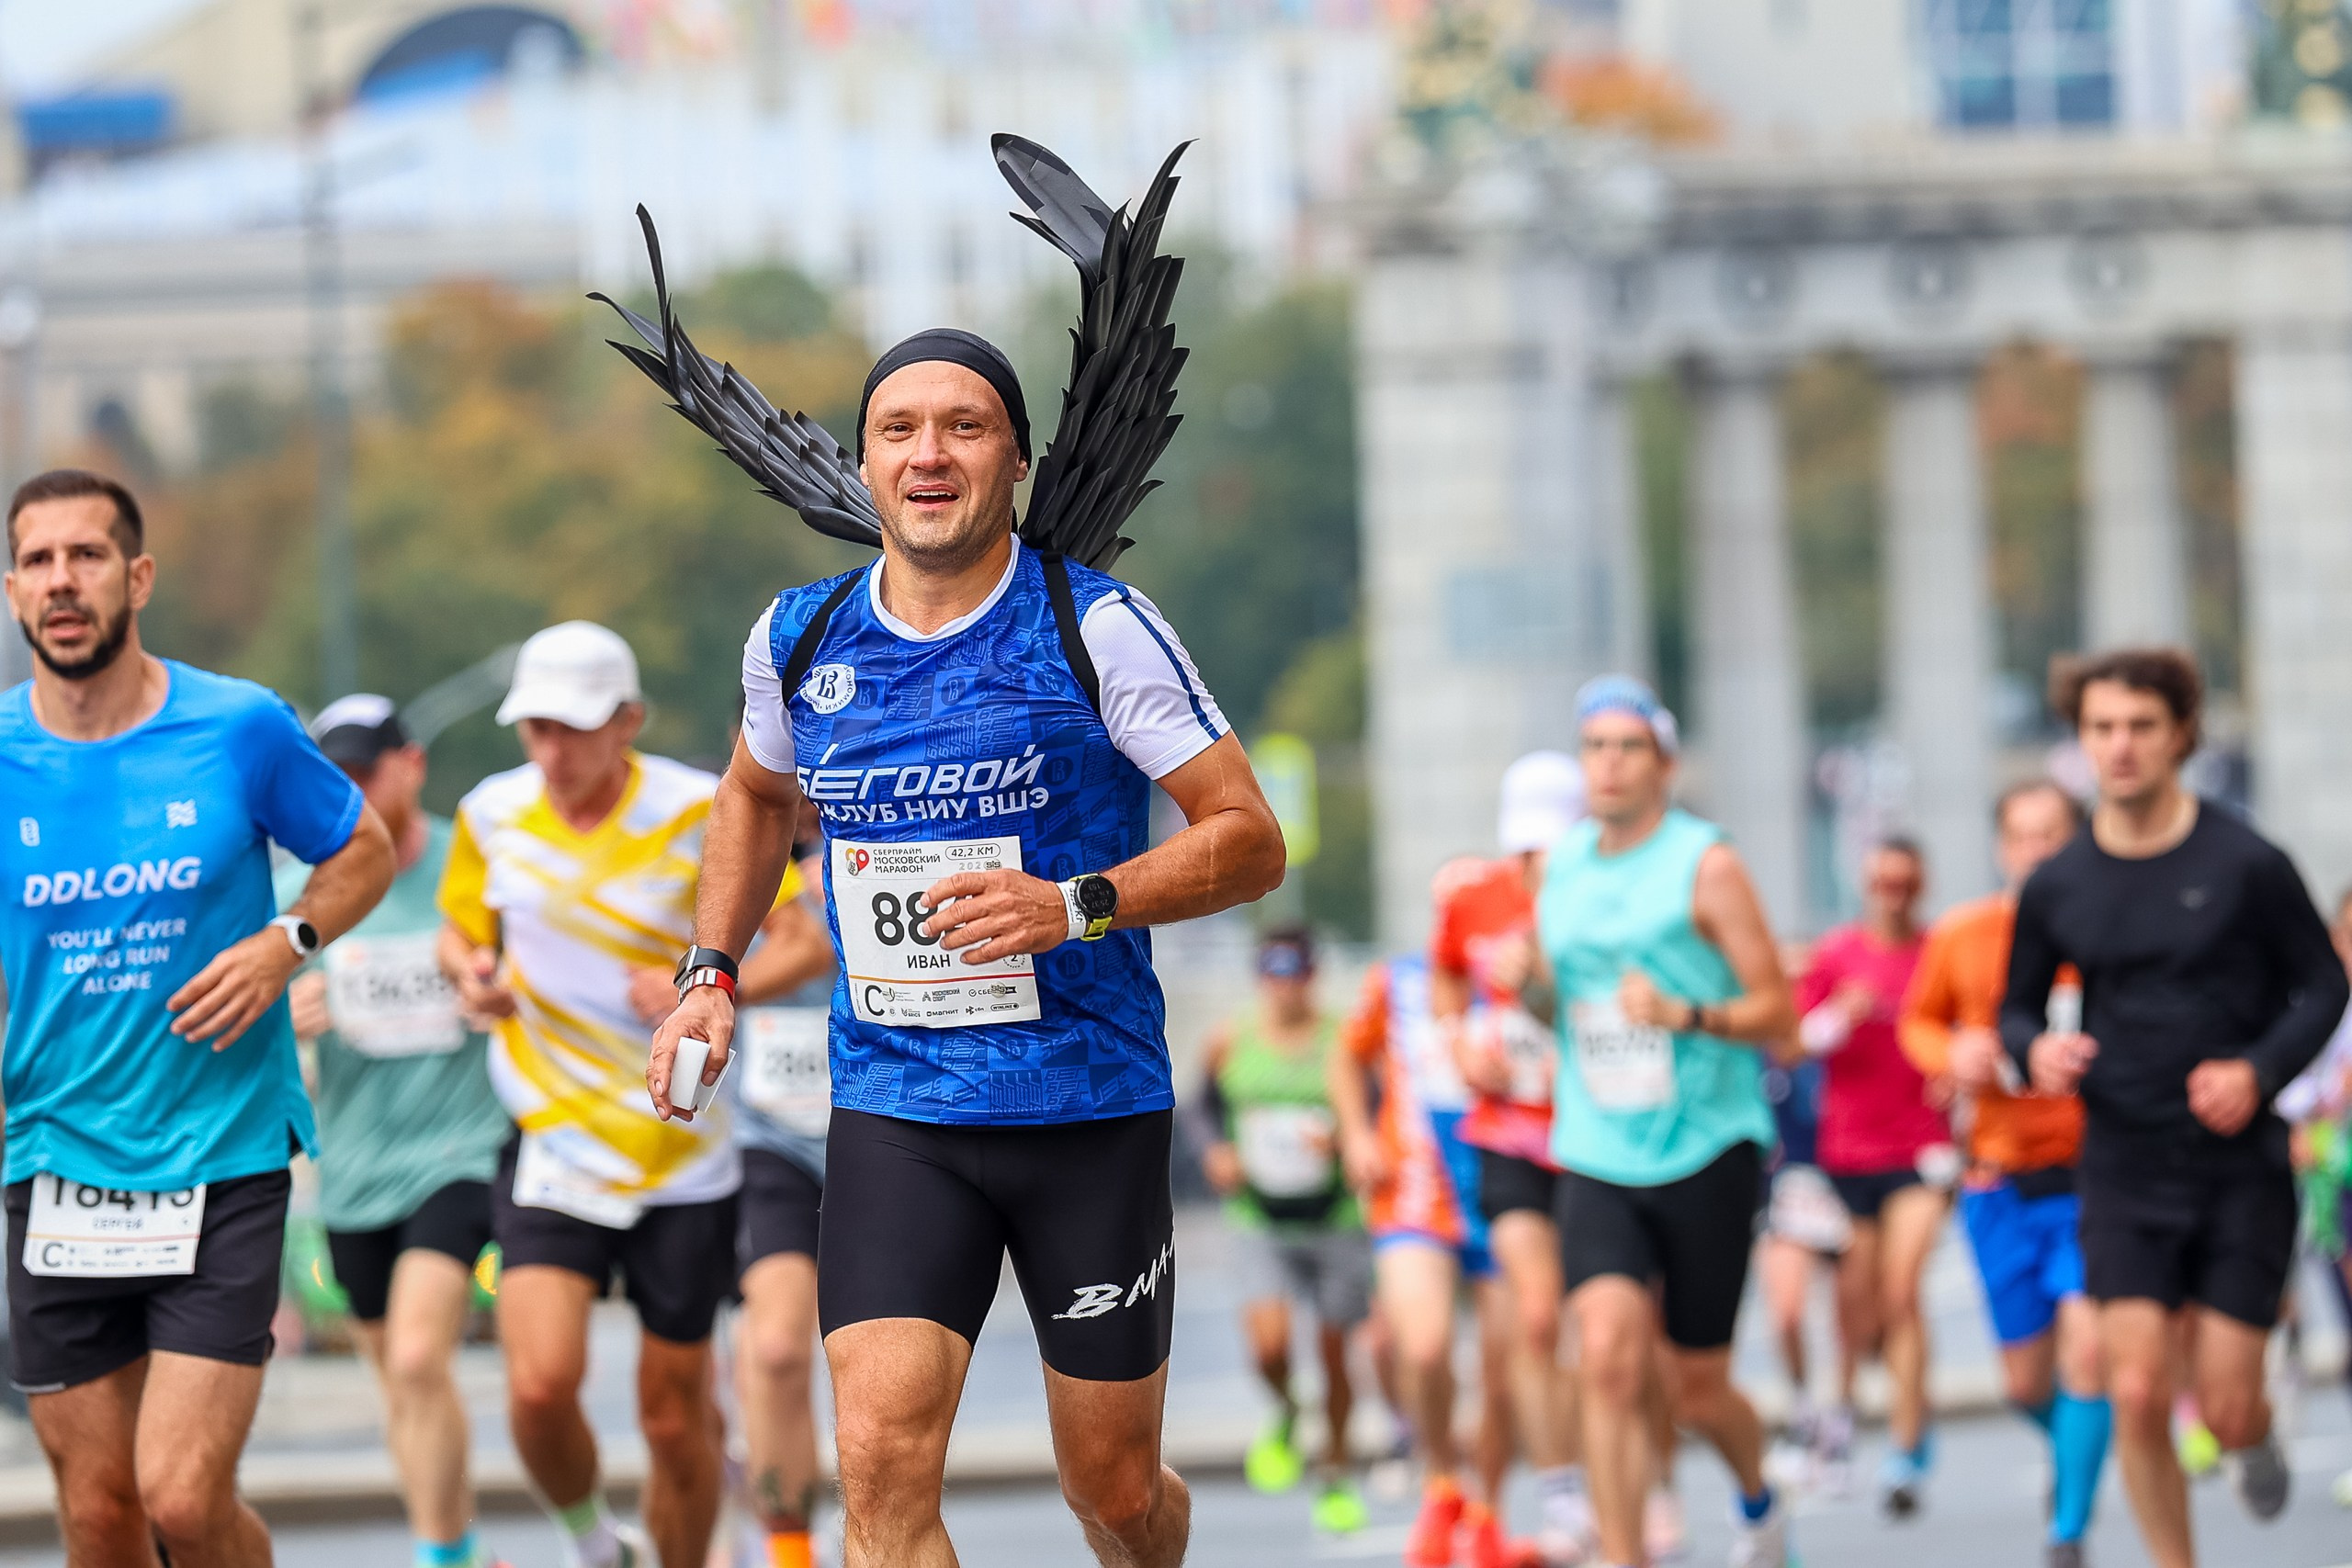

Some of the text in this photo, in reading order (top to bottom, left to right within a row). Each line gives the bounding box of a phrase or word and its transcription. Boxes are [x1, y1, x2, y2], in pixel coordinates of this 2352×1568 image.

[907, 797, 968, 820] НИУ
[978, 787, 1049, 818] ВШЭ
[873, 848, 922, 856] СБЕРПРАЙМ
[874, 854, 941, 865] МОСКОВСКИЙ
[951, 846, 993, 857] 42,2 КМ
[875, 865, 924, 874] МАРАФОН
[958, 862, 981, 871] 202
[23, 855, 202, 908] DDLONG
[120, 917, 187, 942] NEVER
[62, 944, 171, 975] LONG RUN
[907, 953, 951, 969] ИВАН
[82, 970, 153, 996] ALONE
